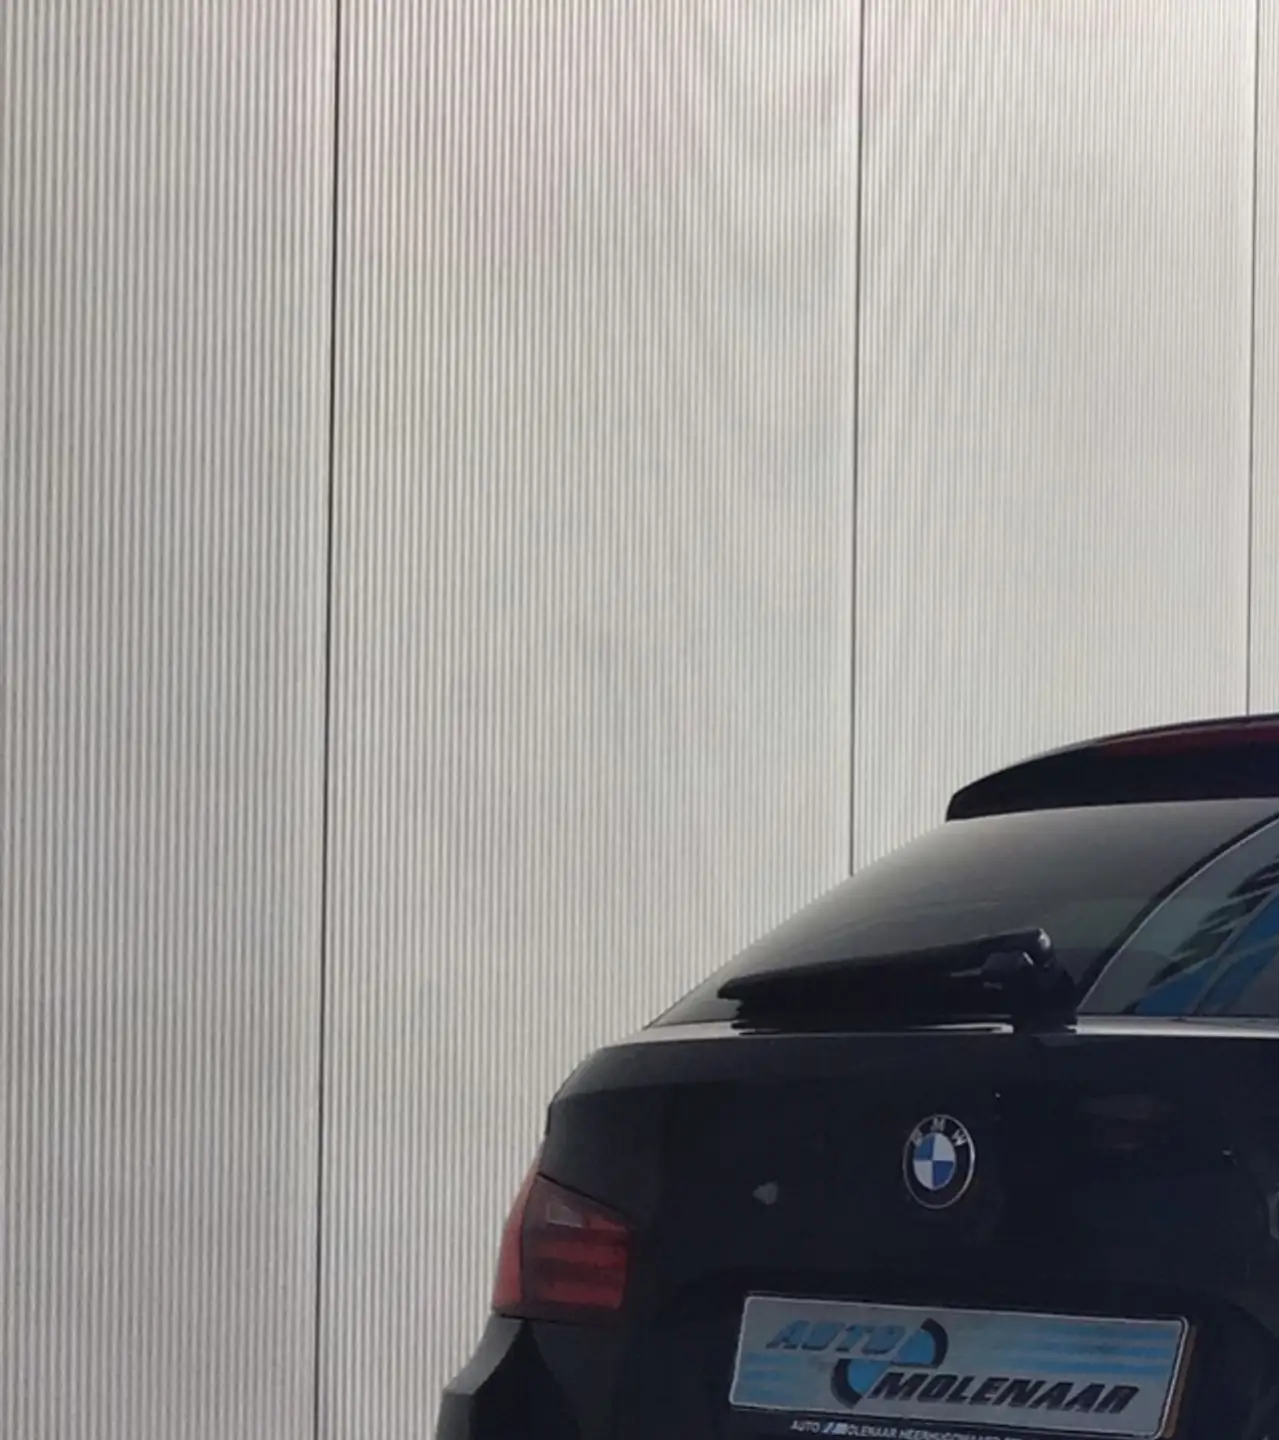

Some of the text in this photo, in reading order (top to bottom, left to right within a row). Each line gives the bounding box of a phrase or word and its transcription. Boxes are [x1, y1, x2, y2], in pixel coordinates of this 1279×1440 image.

[765, 1319, 907, 1355] AUTO
[867, 1371, 1140, 1415] MOLENAAR
[789, 1419, 821, 1434] AUTO
